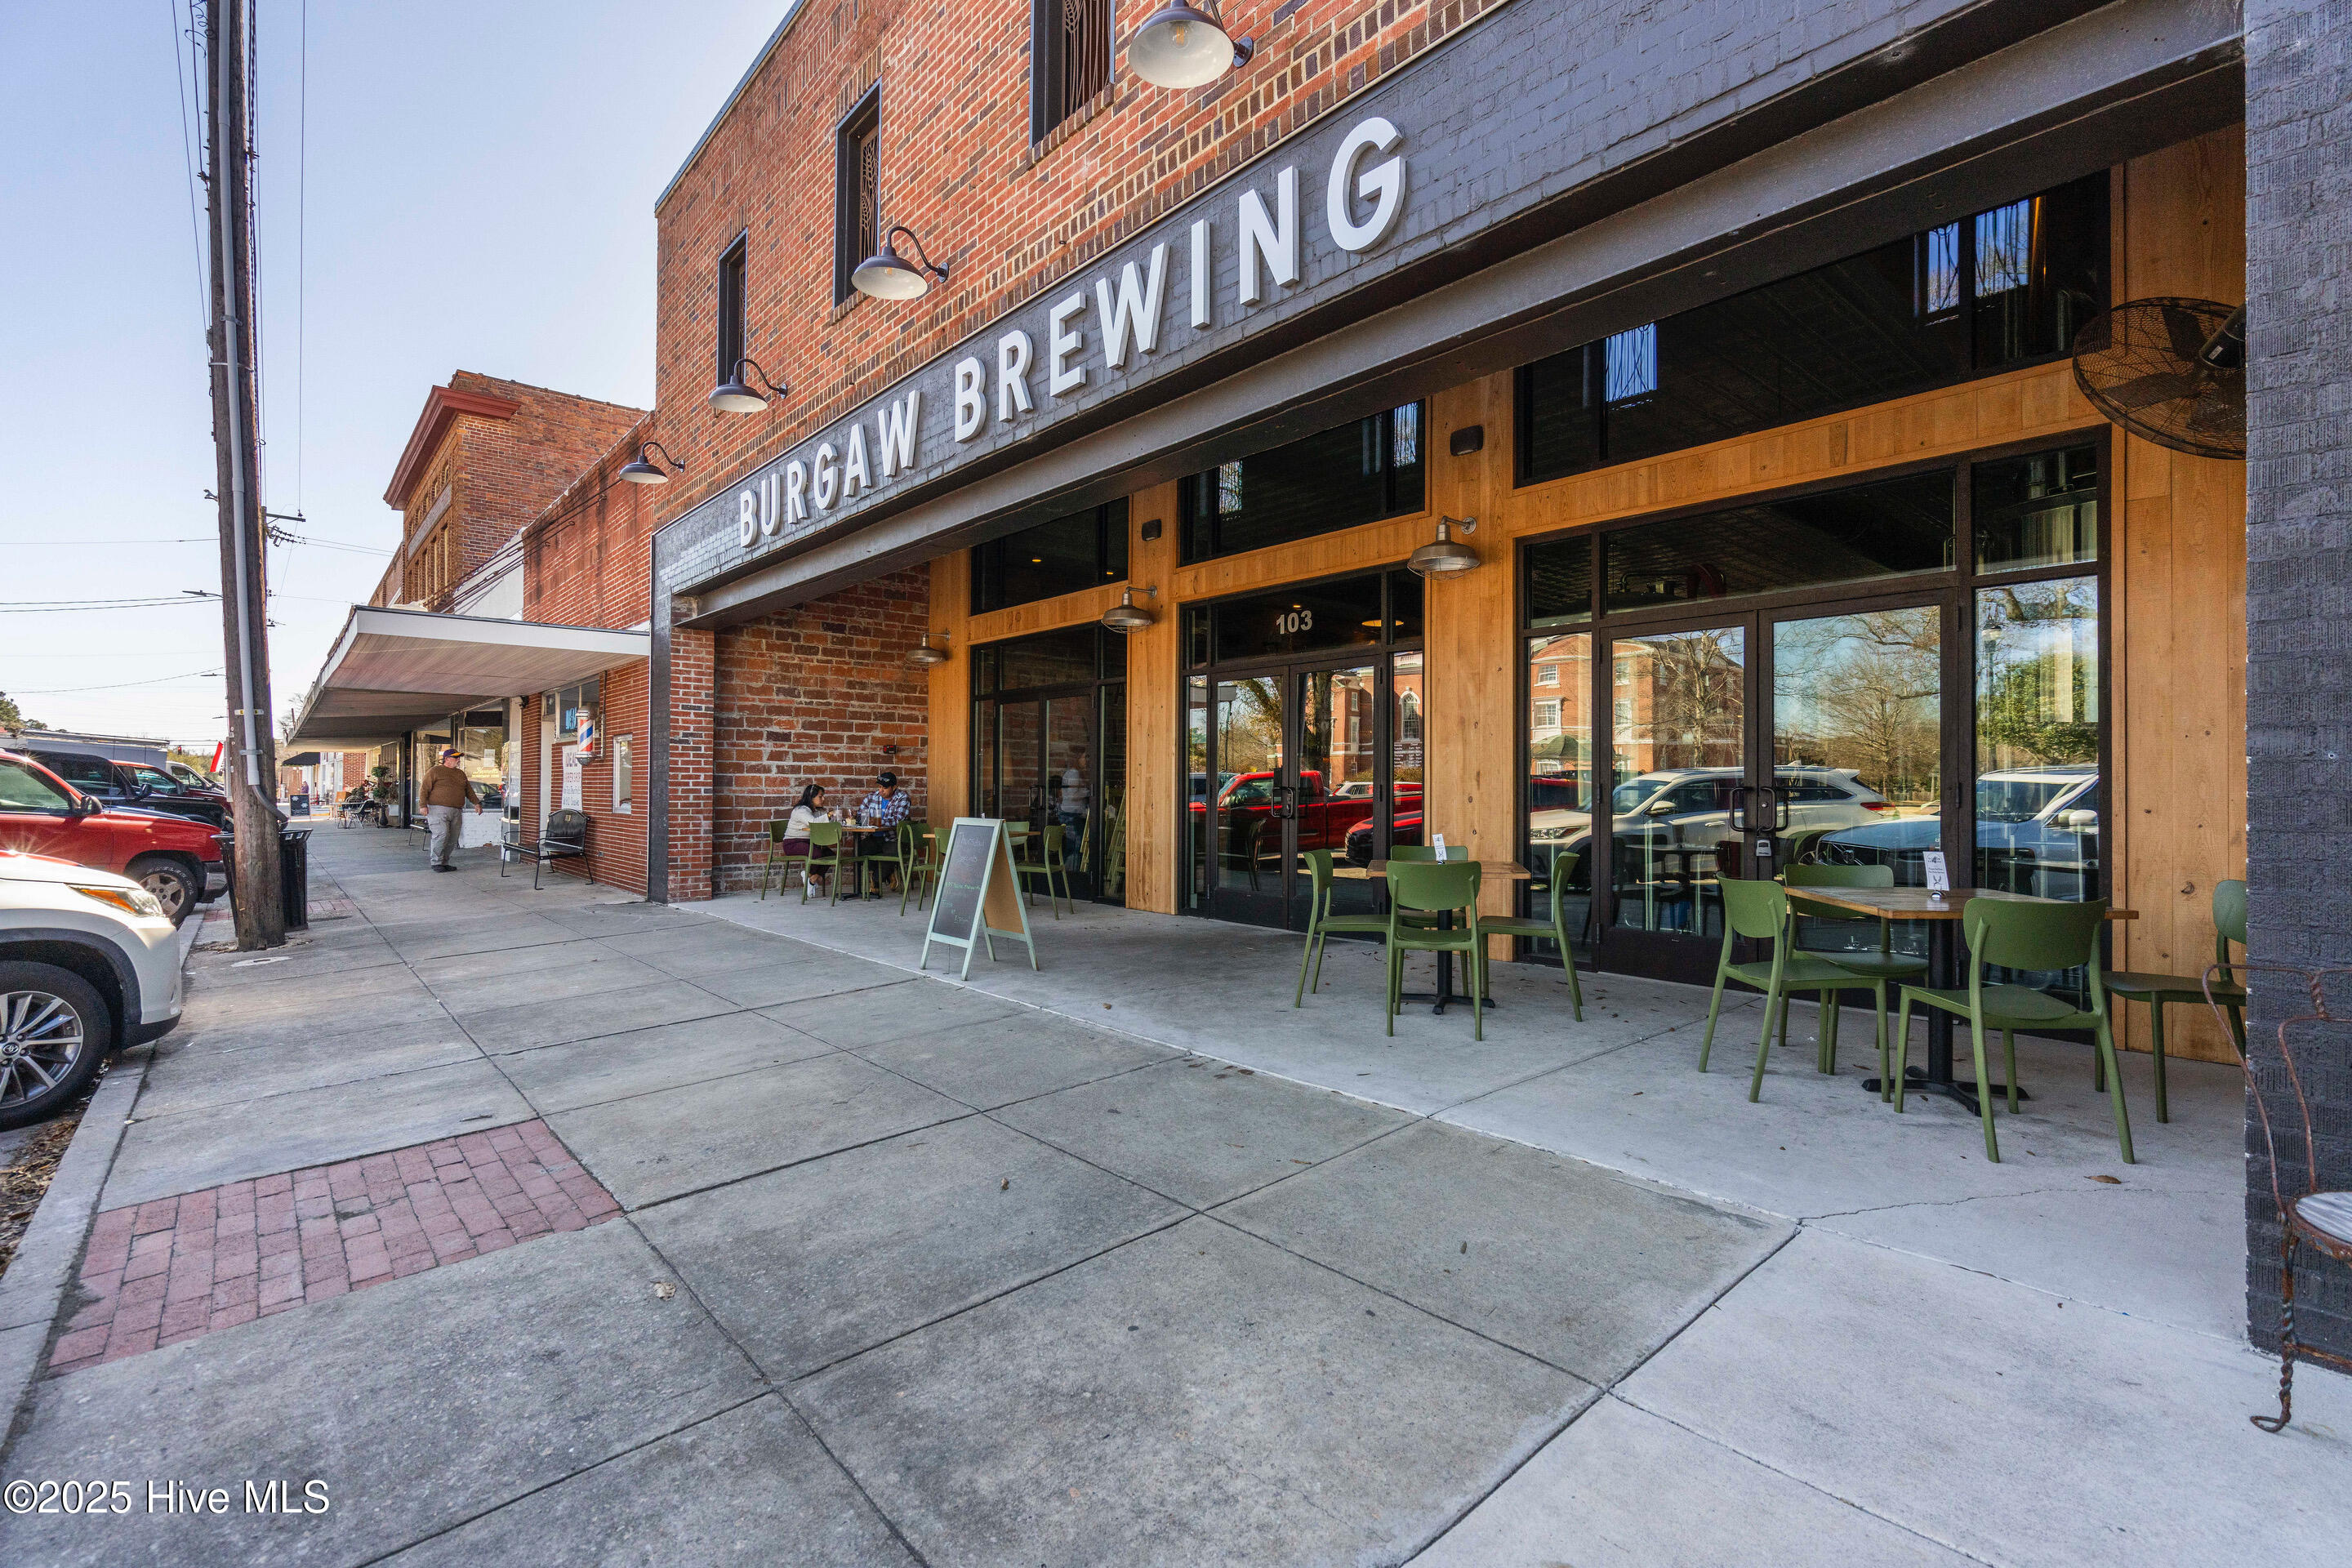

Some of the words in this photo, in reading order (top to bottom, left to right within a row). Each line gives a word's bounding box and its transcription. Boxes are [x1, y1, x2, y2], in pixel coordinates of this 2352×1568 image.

[740, 390, 921, 548] BURGAW
[955, 117, 1406, 443] BREWING
[1276, 610, 1312, 635] 103
